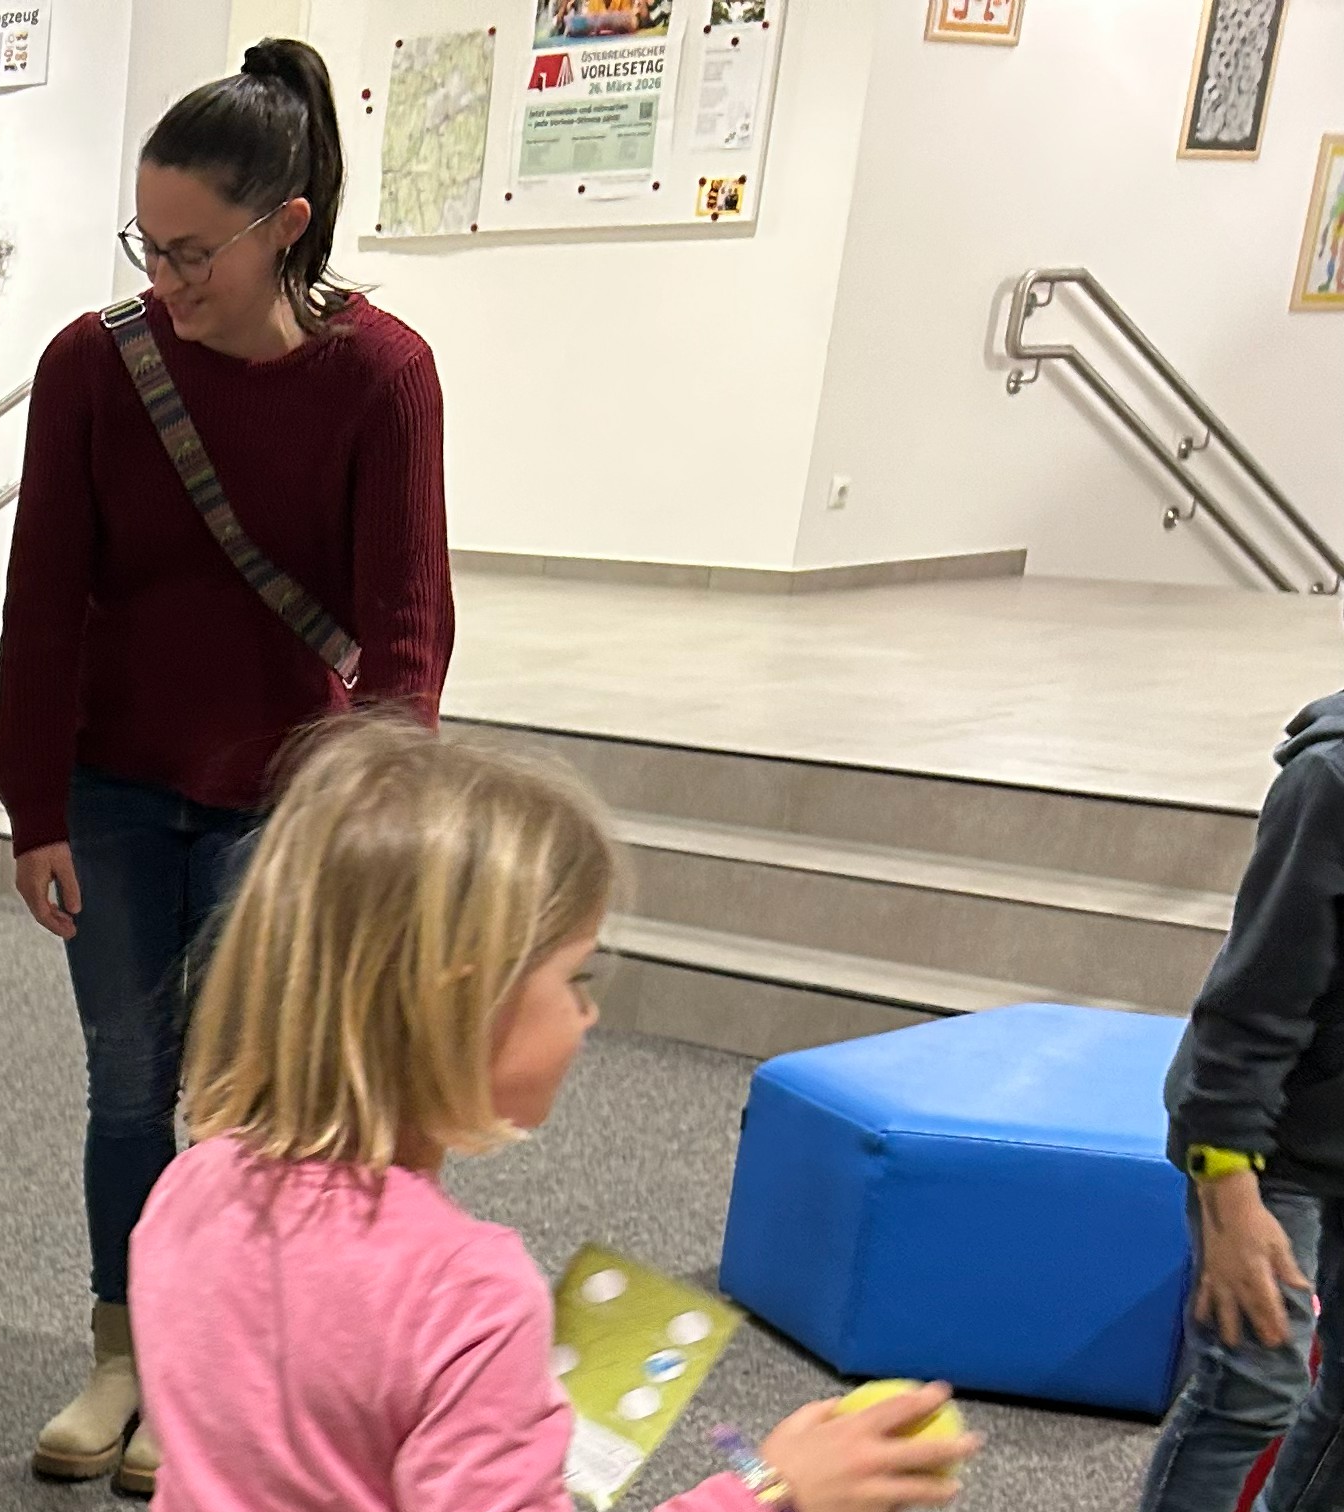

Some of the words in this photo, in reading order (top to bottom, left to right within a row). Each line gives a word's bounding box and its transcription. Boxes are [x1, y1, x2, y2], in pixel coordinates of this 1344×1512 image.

[581, 45, 666, 63] ÖSTERREICHISCHER
[581, 58, 665, 80] VORLESETAG
[588, 82, 603, 95] 26.
[606, 79, 632, 92] März
[635, 77, 662, 90] 2026
